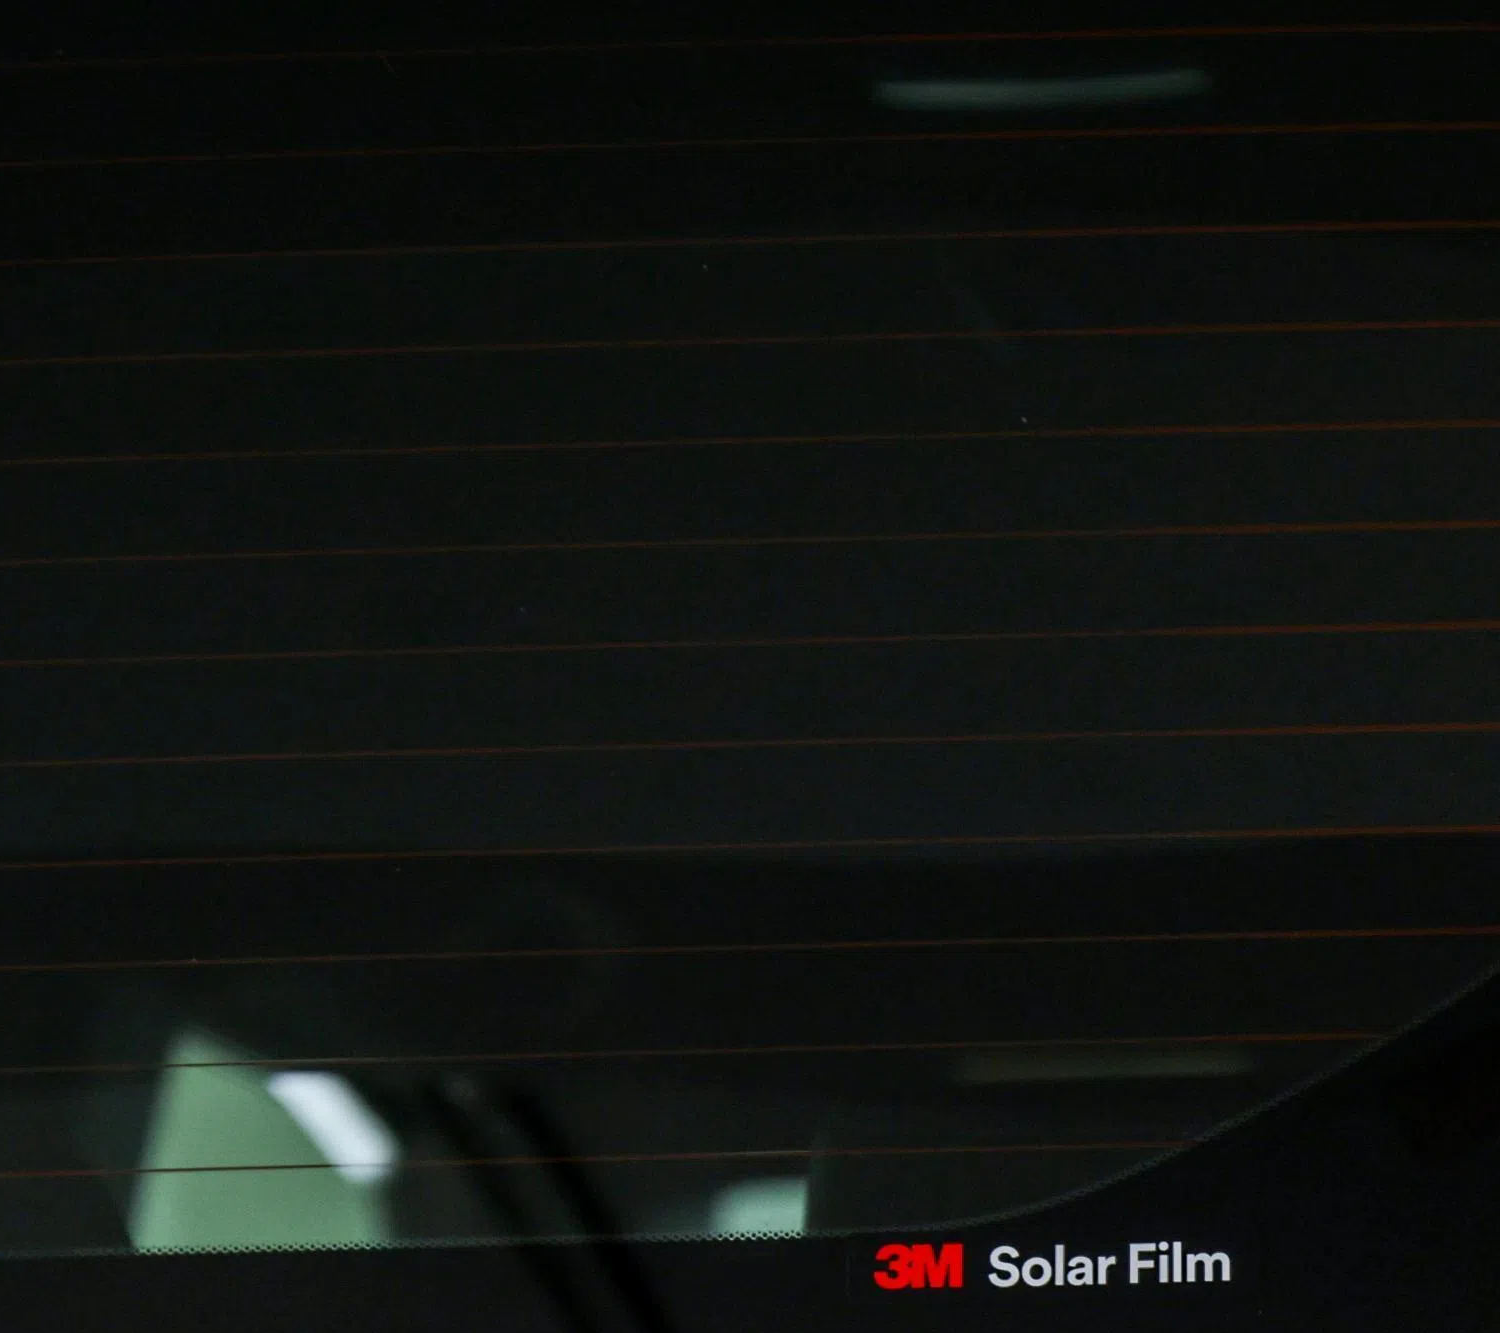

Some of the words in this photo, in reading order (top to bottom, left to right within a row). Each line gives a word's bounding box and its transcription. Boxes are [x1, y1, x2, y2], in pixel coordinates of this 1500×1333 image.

[873, 1243, 963, 1290] 3M
[988, 1245, 1116, 1288] Solar
[1129, 1241, 1231, 1284] Film
